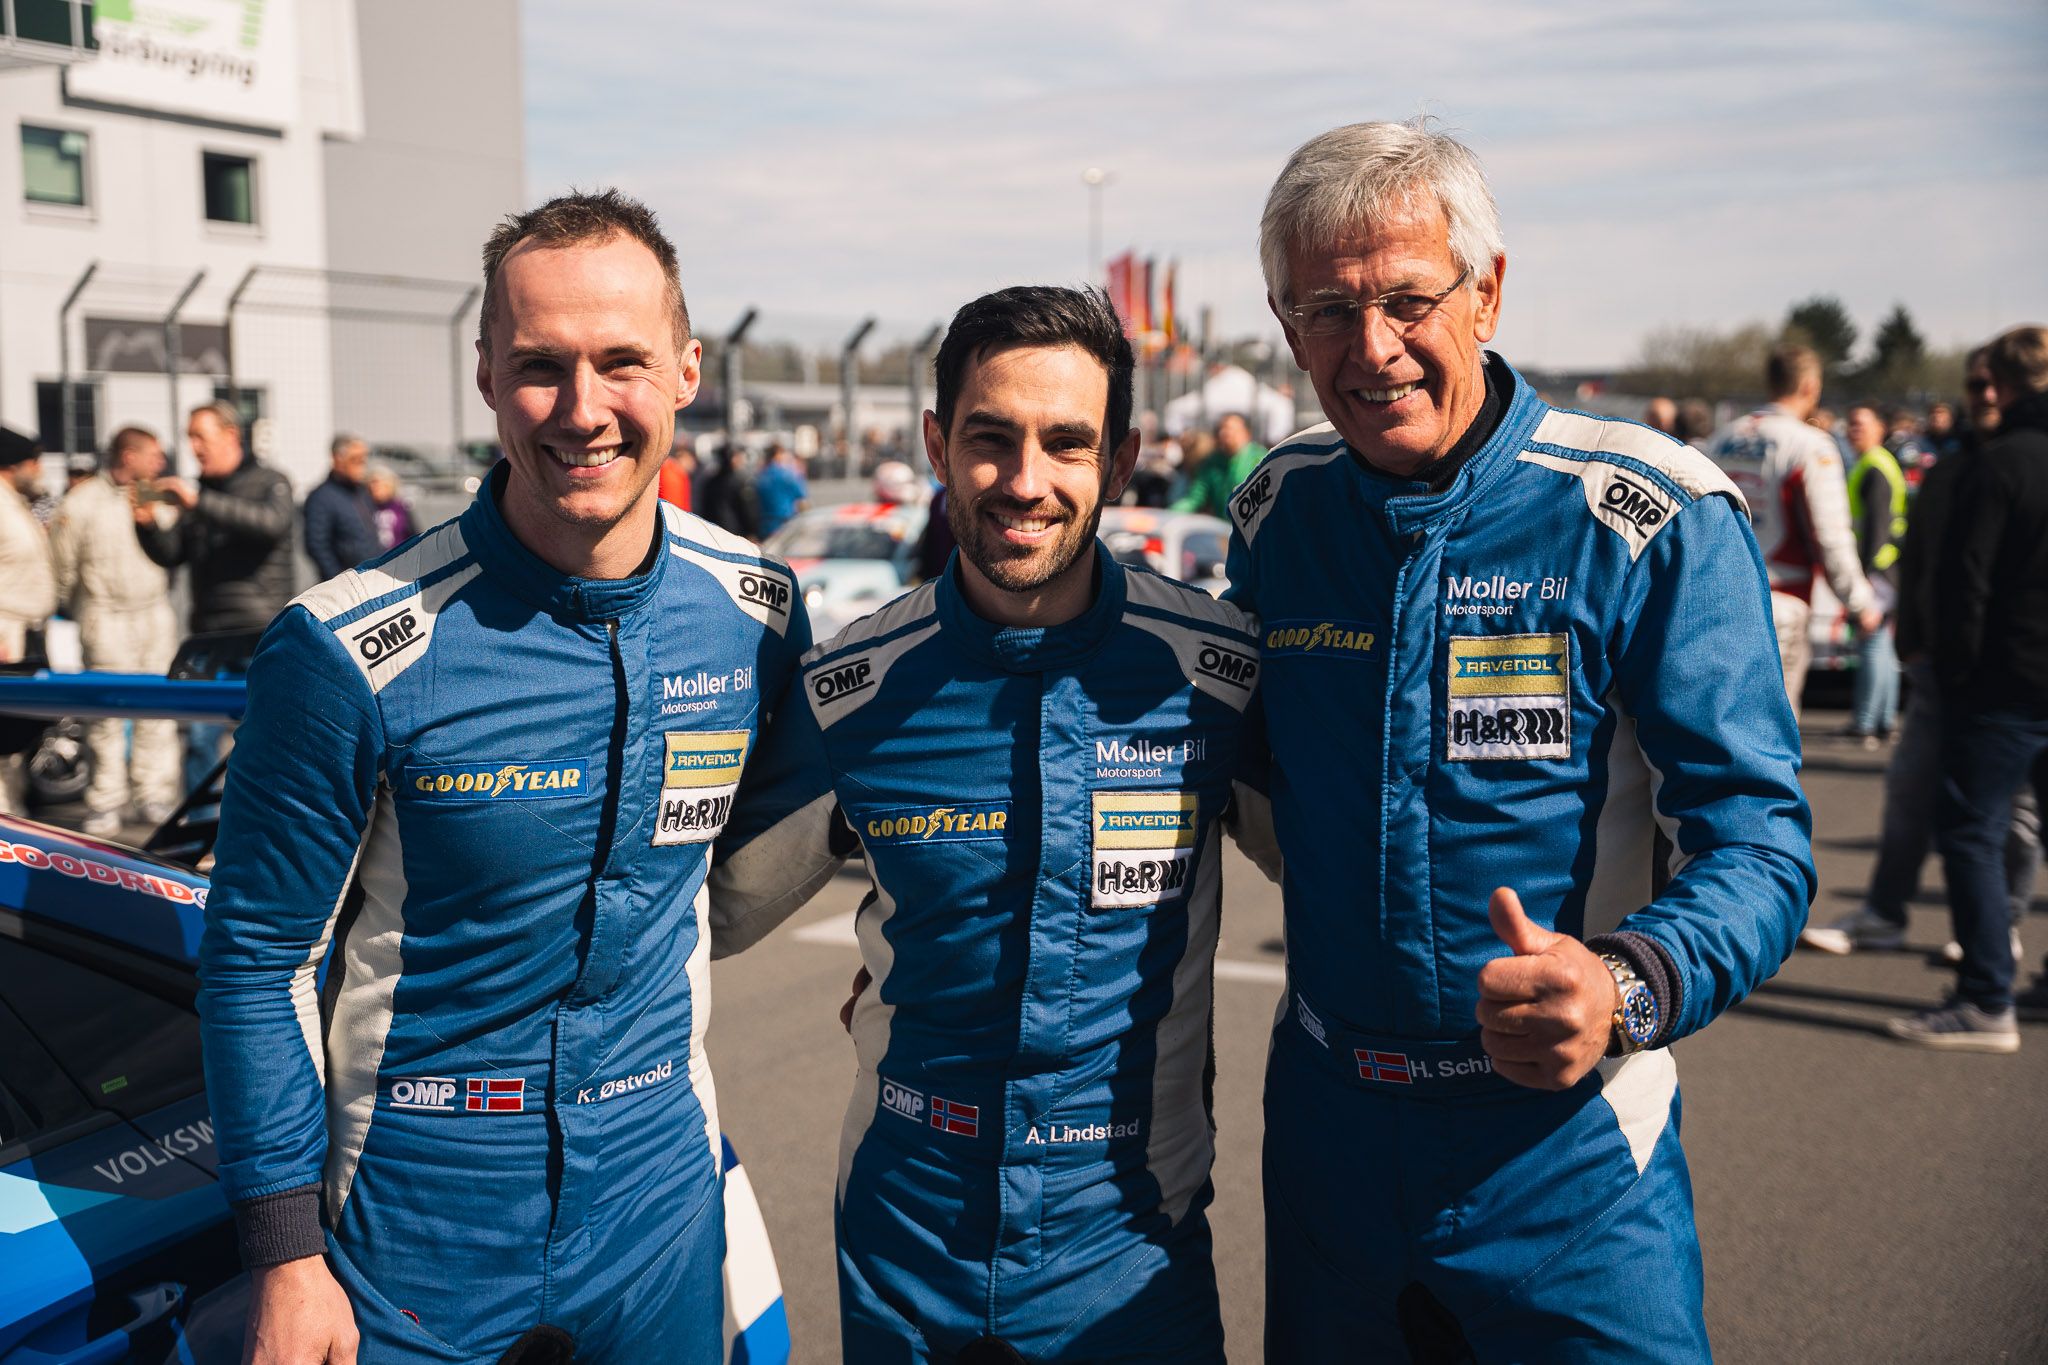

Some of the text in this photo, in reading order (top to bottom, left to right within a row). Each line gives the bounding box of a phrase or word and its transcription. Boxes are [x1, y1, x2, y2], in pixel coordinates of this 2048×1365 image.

[1238, 473, 1272, 520] OMP
[1603, 482, 1662, 528] OMP
[739, 574, 789, 606] OMP
[1540, 577, 1568, 600] Bil
[1445, 604, 1513, 617] Motorsport
[360, 612, 417, 660] OMP
[1199, 646, 1256, 683] OMP
[1465, 658, 1552, 674] RAVENOL
[734, 666, 752, 691] Bil
[813, 661, 871, 700] OMP
[661, 699, 718, 715] Motorsport
[1454, 708, 1526, 746] H&R
[677, 753, 737, 767] RAVENOL
[1184, 739, 1206, 762] Bil
[1096, 767, 1162, 779] Motorsport
[661, 798, 714, 834] H&R
[1108, 814, 1185, 827] RAVENOL
[1098, 860, 1161, 895] H&R
[577, 1059, 672, 1105] K. Østvold
[1410, 1059, 1433, 1078] H.
[391, 1080, 457, 1107] OMP
[882, 1083, 925, 1117] OMP
[1024, 1120, 1140, 1145] A. Lindstad
